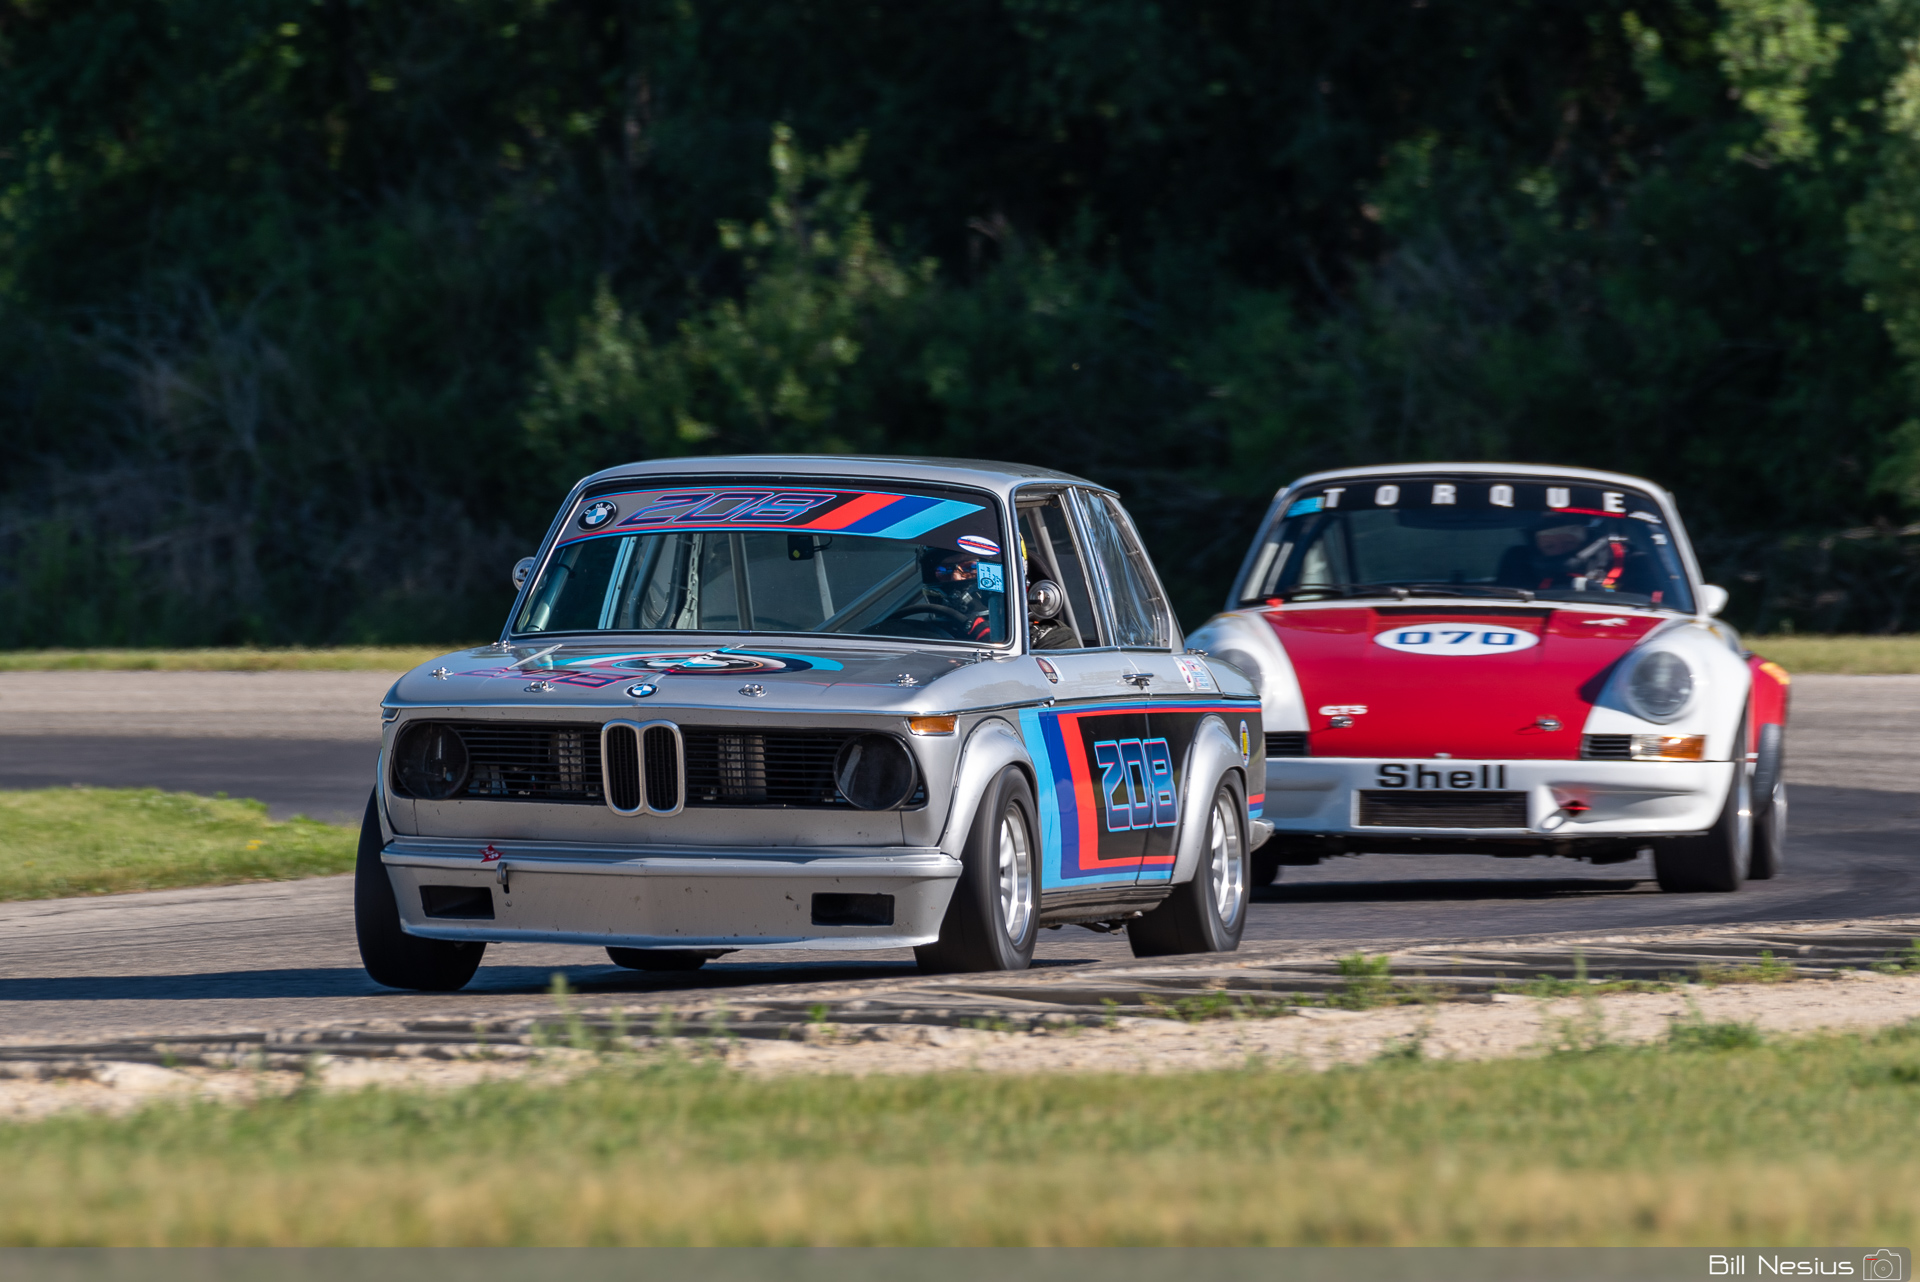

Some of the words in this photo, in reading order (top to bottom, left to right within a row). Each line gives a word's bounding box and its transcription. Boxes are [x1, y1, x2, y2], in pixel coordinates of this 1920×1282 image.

[615, 492, 837, 527] 208
[1323, 484, 1626, 513] TORQUE
[1398, 631, 1516, 645] 070
[1094, 737, 1179, 833] 208
[1376, 763, 1507, 789] Shell
